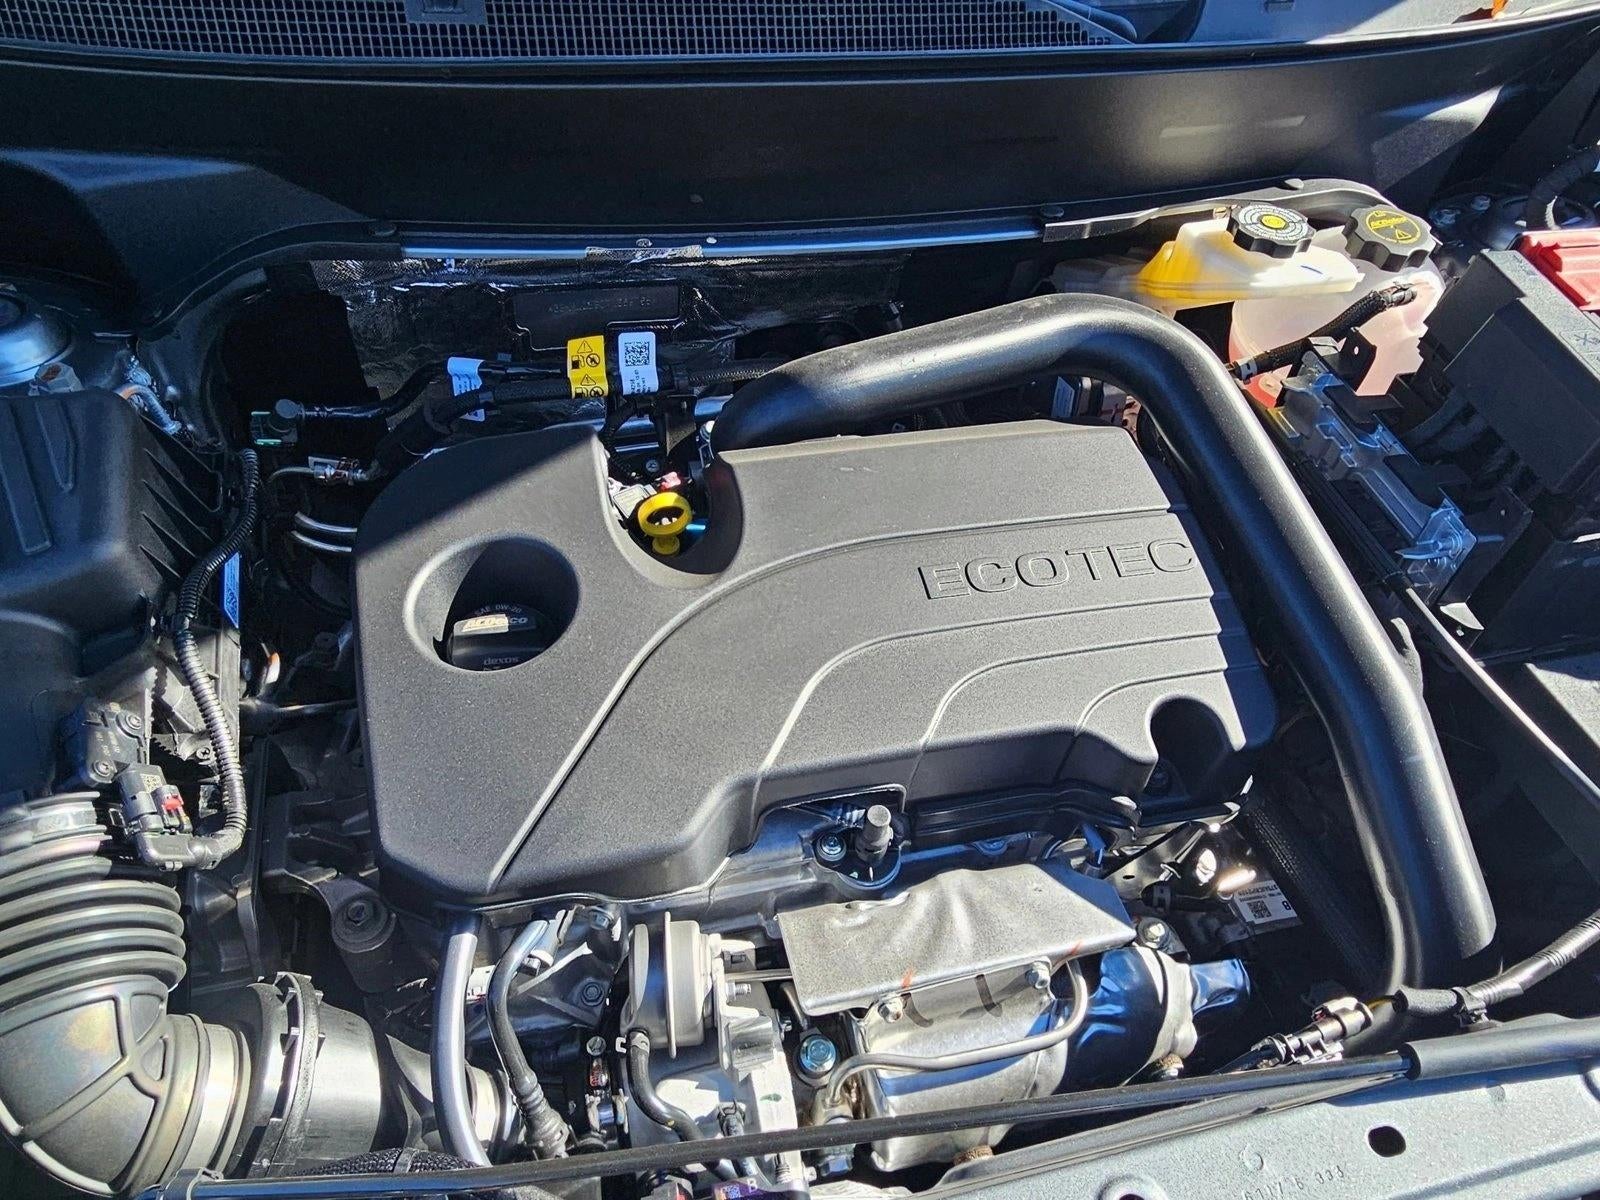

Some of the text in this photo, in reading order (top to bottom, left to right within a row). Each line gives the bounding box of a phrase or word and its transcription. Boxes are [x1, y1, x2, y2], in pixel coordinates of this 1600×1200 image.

[917, 538, 1197, 600] ECOTEC
[474, 605, 491, 616] SAE
[483, 656, 519, 666] dexos
